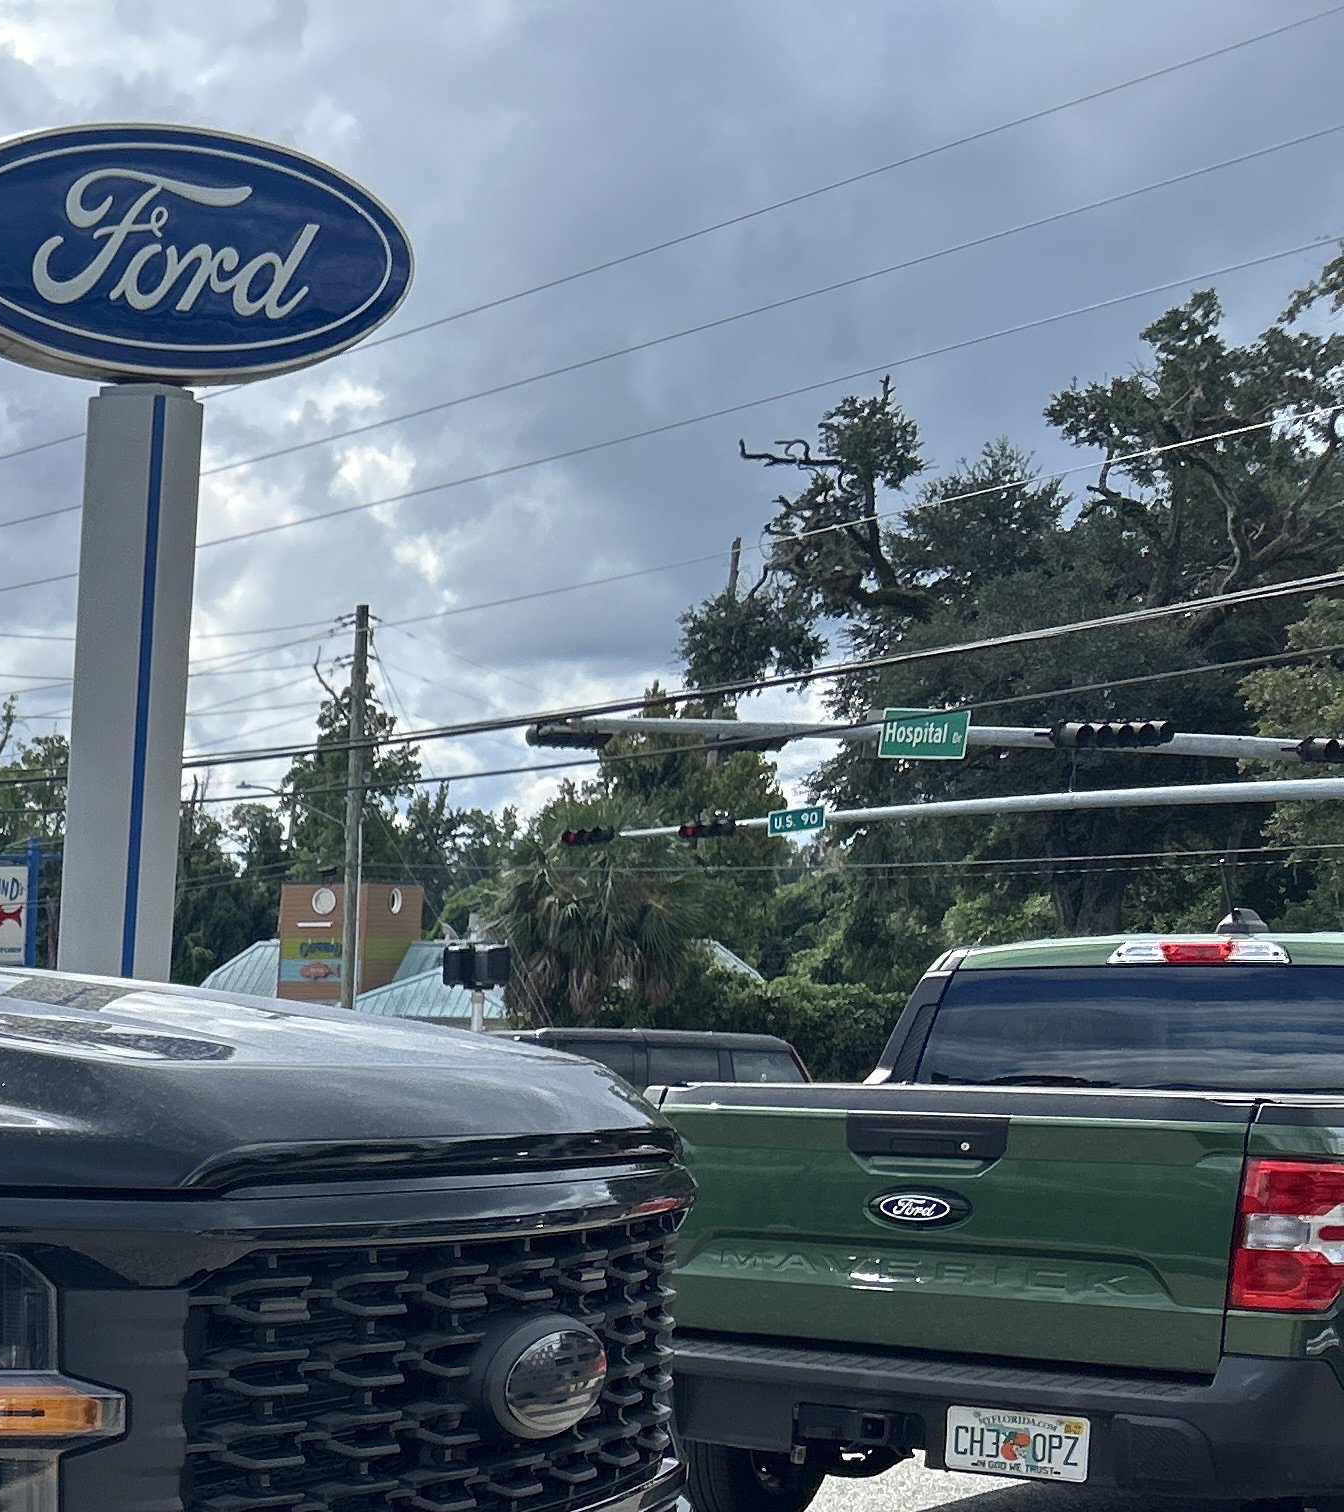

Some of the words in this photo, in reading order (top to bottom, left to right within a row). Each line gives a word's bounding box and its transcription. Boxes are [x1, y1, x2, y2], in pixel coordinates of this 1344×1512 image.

[32, 168, 320, 320] Ford
[885, 721, 948, 748] Hospital
[952, 731, 962, 744] Dr
[774, 815, 796, 829] U.S.
[800, 812, 818, 826] 90
[892, 1198, 937, 1217] Ford
[719, 1250, 1132, 1296] MAVERICK
[979, 1415, 1057, 1432] MYFLORIDA.COM
[954, 1425, 1000, 1458] CH3
[987, 1461, 1007, 1471] GOD
[1009, 1463, 1022, 1472] WE
[1025, 1464, 1055, 1476] TRUST
